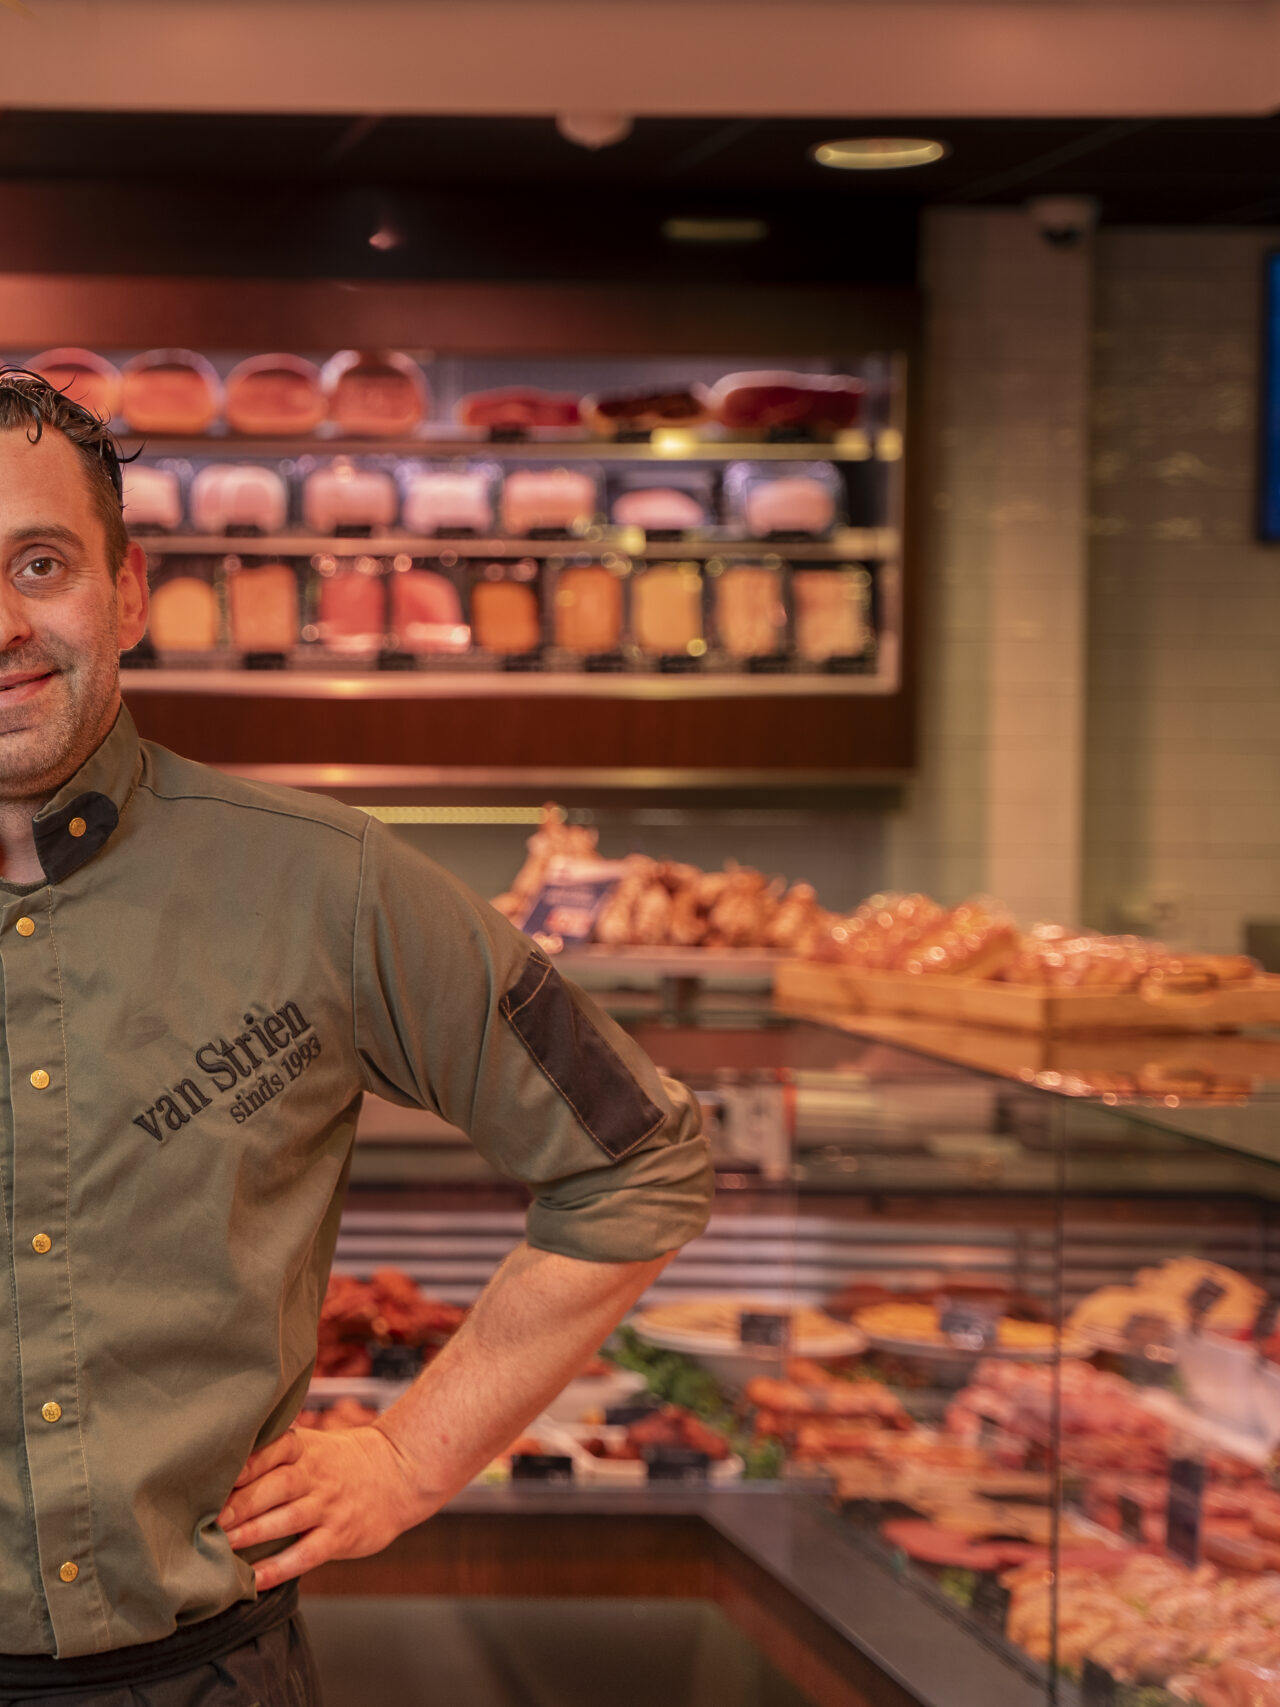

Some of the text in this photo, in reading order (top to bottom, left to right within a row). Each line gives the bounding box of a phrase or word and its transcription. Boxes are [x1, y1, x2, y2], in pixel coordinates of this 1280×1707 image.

[132, 1000, 311, 1142] van Strien
[229, 1072, 285, 1124] sinds
